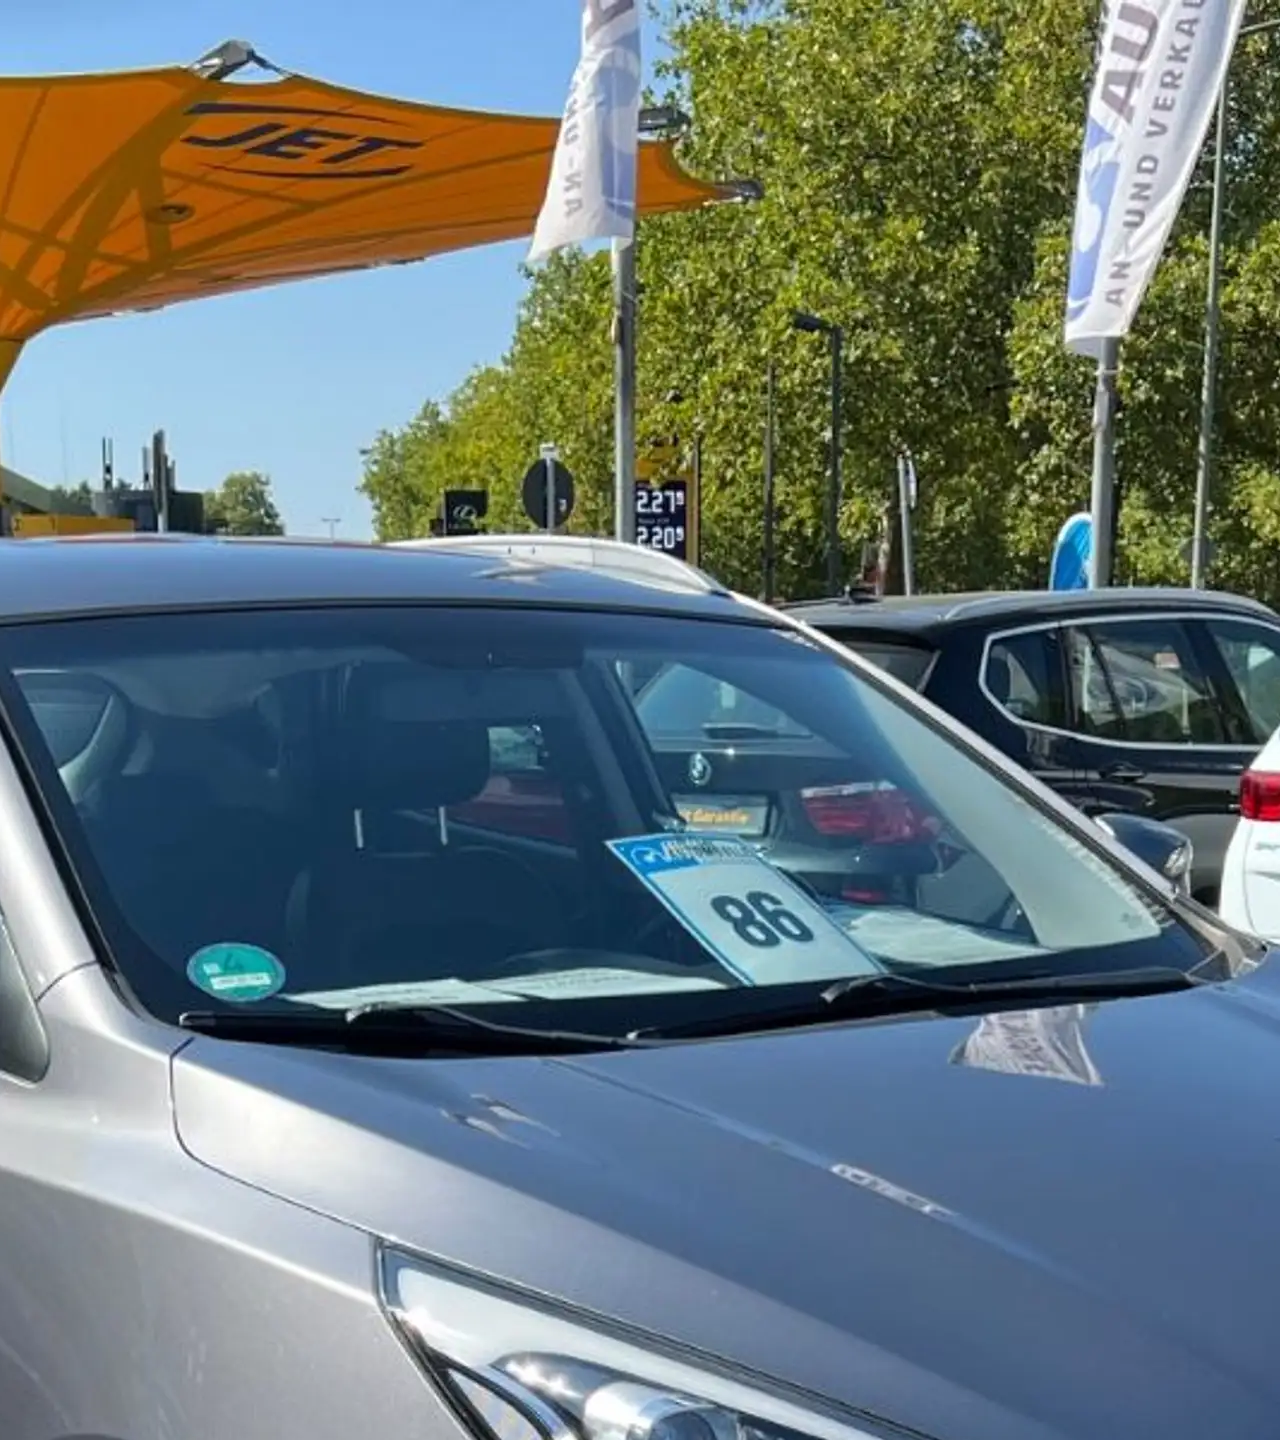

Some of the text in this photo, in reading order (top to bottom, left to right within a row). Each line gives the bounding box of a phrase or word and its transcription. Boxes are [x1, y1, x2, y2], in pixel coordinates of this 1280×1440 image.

[180, 122, 424, 165] JET
[1123, 155, 1160, 228] UND
[710, 890, 815, 948] 86
